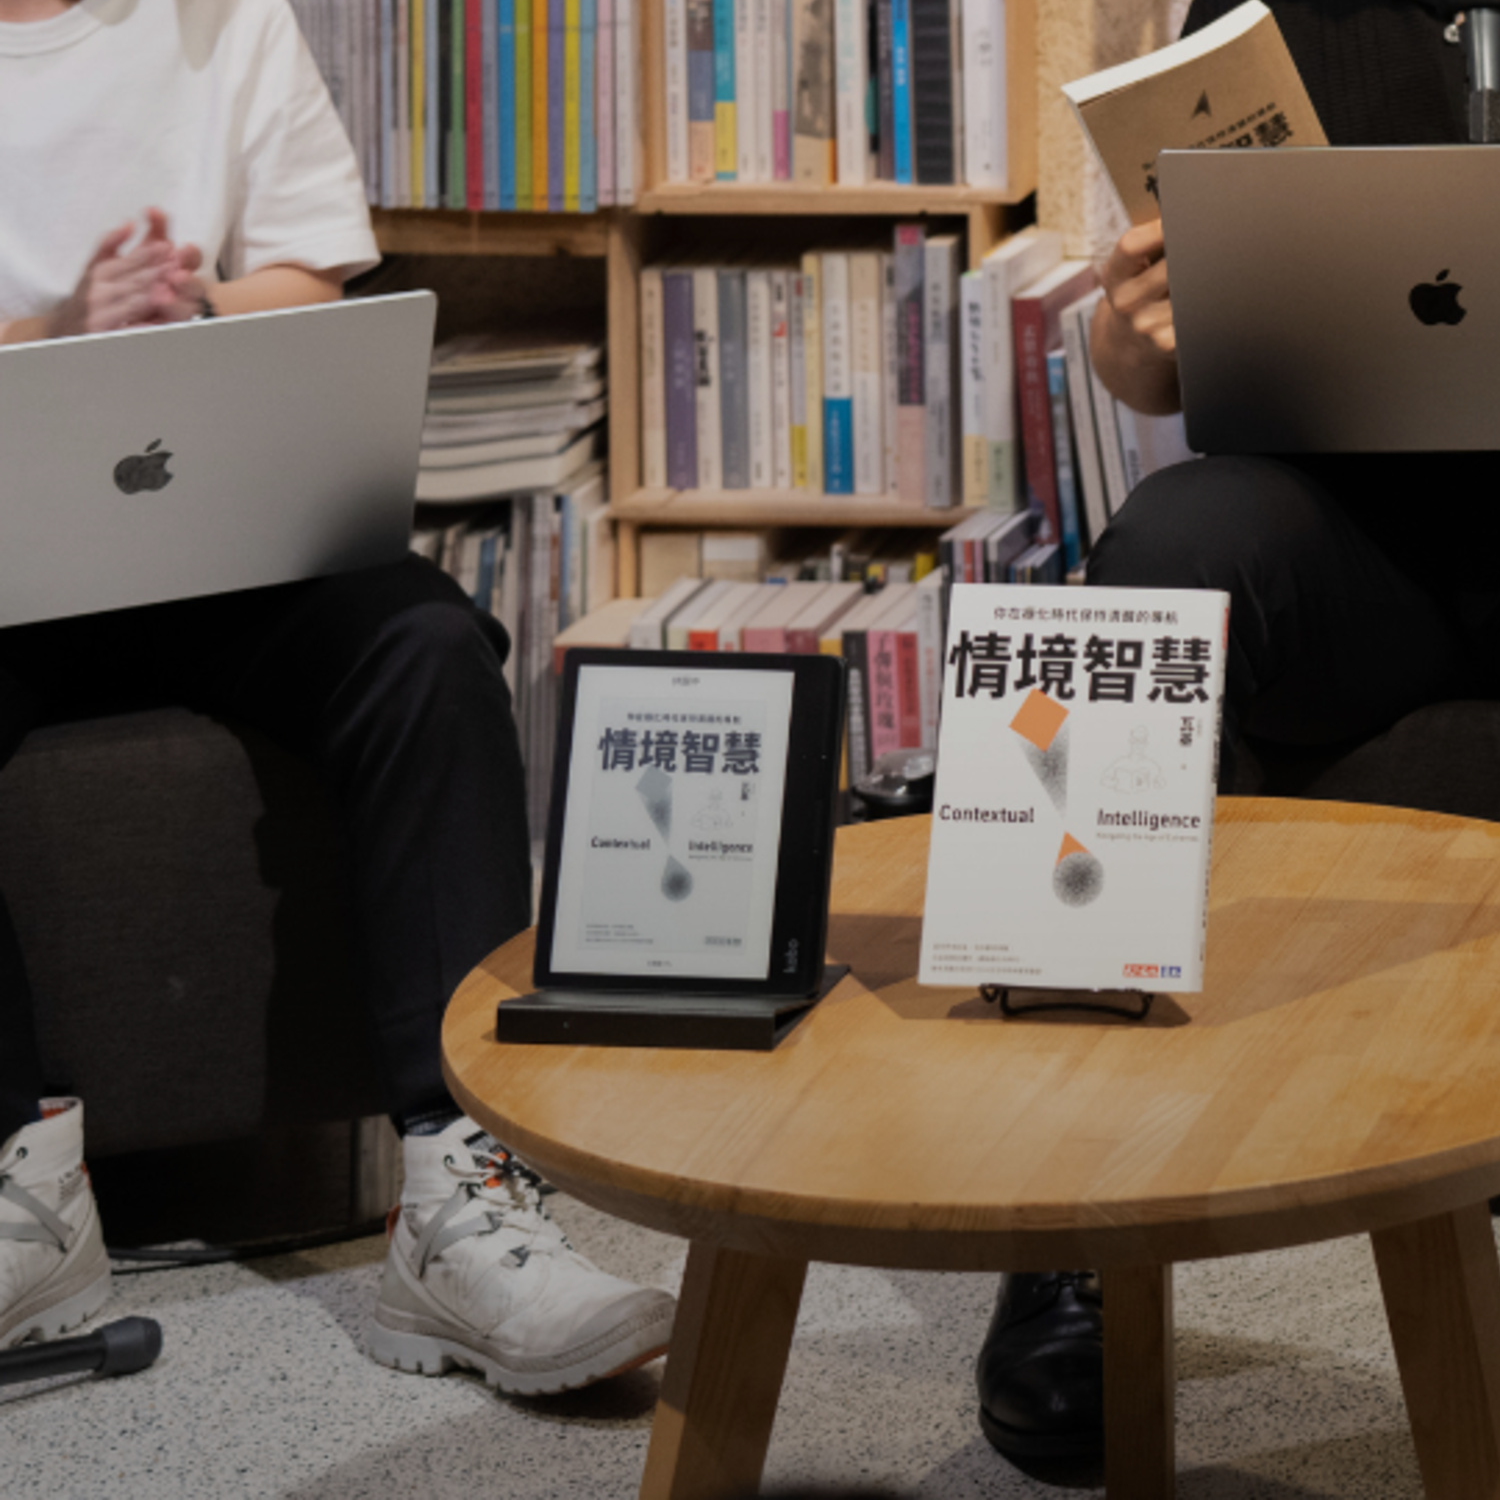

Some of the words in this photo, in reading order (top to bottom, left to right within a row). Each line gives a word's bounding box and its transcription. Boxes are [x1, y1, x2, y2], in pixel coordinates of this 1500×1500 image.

[949, 630, 1212, 704] 情境智慧
[597, 727, 762, 775] 情境智慧
[938, 804, 1035, 824] Contextual
[1096, 807, 1201, 830] Intelligence
